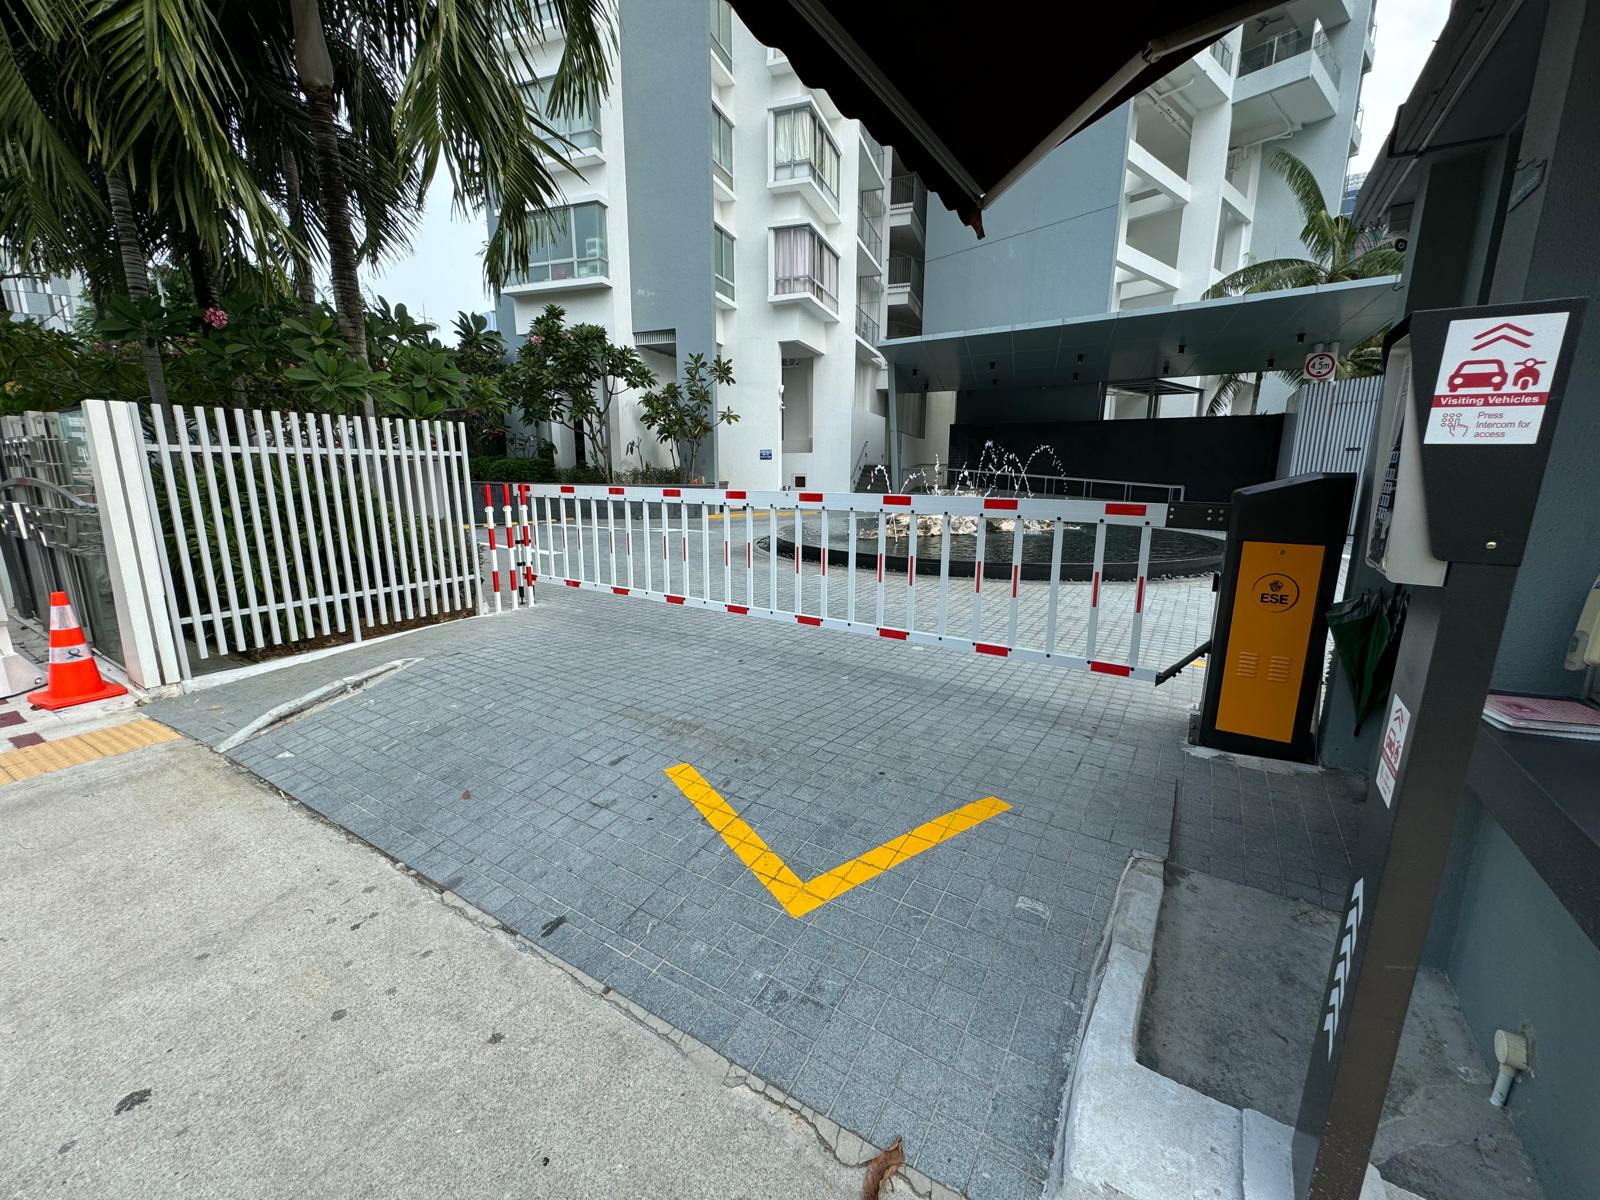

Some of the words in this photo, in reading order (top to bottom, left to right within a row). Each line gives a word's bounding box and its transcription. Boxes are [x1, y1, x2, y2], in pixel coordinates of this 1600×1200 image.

[1311, 361, 1330, 370] 4.5m
[1440, 397, 1483, 406] Visiting
[1488, 395, 1540, 404] Vehicles
[1477, 411, 1504, 419] Press
[1475, 420, 1515, 429] Intercom
[1517, 420, 1531, 428] for
[1260, 593, 1289, 604] ESE
